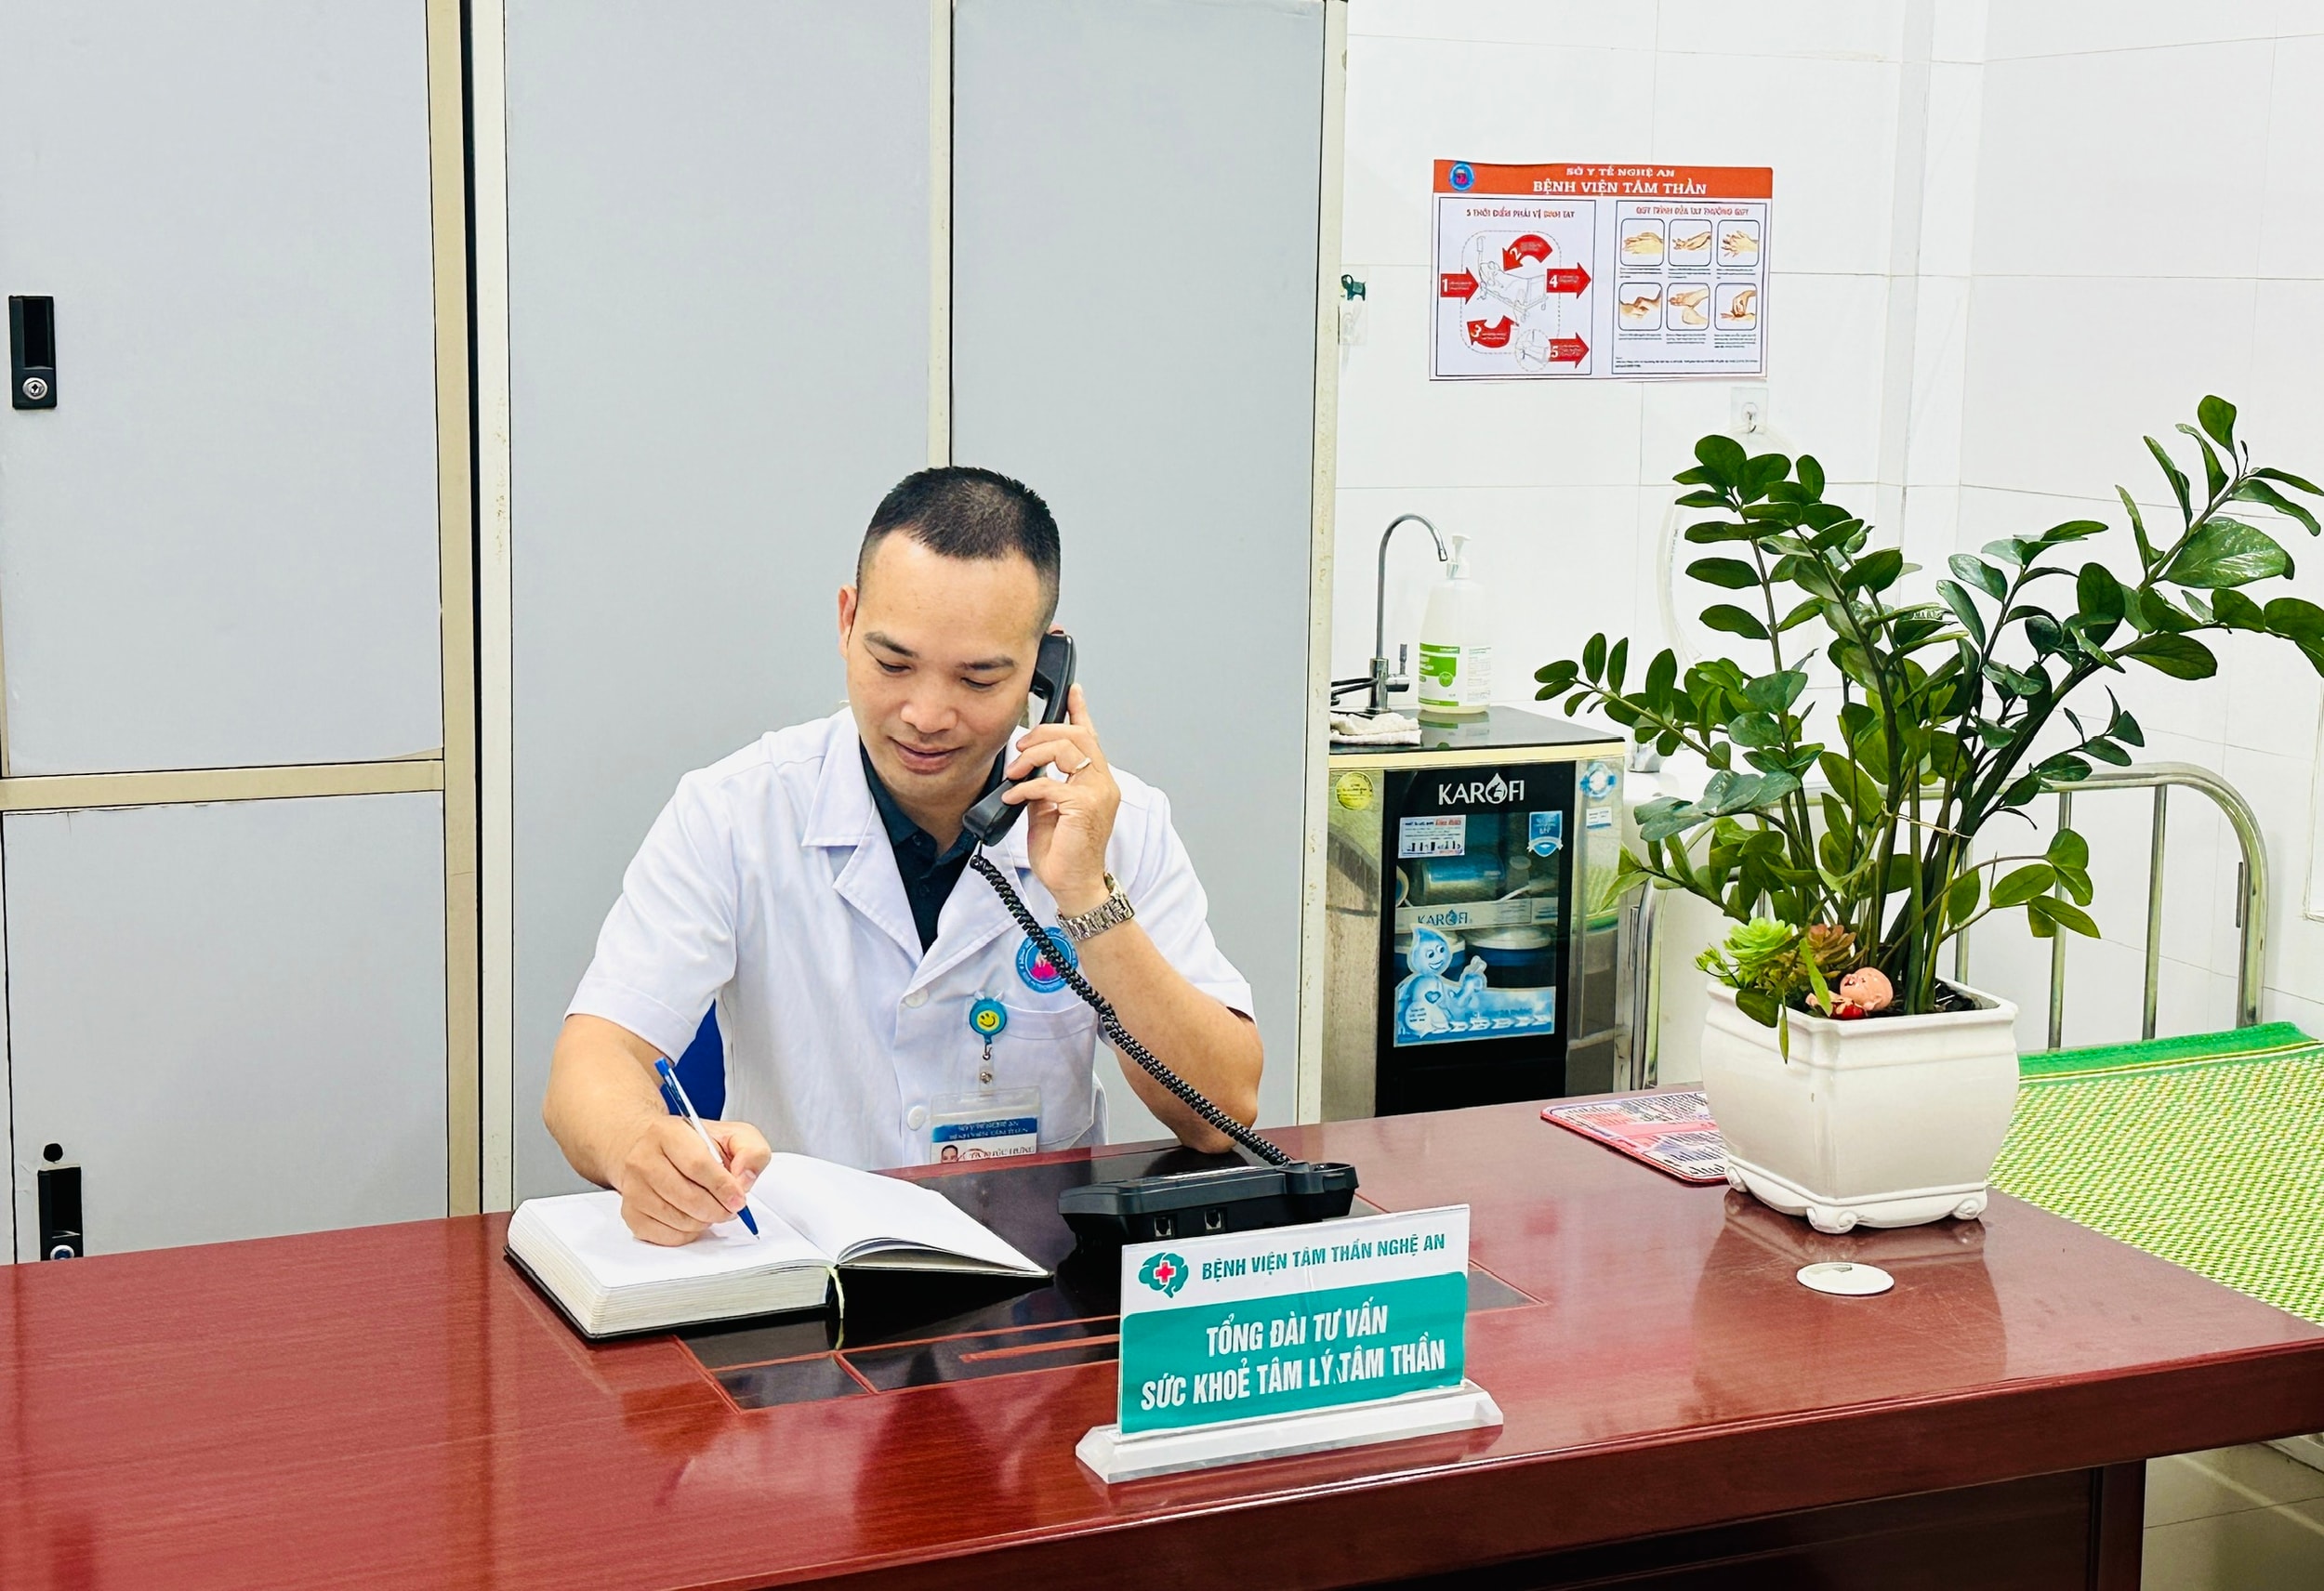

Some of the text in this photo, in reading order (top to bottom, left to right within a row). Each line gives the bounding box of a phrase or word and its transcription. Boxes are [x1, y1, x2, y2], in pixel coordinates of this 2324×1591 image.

[1587, 167, 1596, 176] Y
[1618, 167, 1653, 178] NGHỆ
[1657, 169, 1675, 178] AN
[1533, 178, 1707, 196] BỆNH VIỆN TÂM THẦN
[1510, 247, 1522, 260] 2
[1442, 278, 1448, 293] 1
[1549, 274, 1559, 288] 4
[1471, 324, 1482, 337] 3
[1551, 345, 1559, 358] 5
[1438, 772, 1525, 806] KAROFI
[1202, 1258, 1246, 1282] BỆNH
[1251, 1251, 1287, 1275] VIỆN
[1292, 1246, 1326, 1268] TÂM
[1377, 1234, 1419, 1256] NGHỆ
[1423, 1233, 1446, 1251] AN
[1207, 1296, 1389, 1358] TỔNG ĐÀI TƯ VẤN
[1141, 1373, 1187, 1411] SỨC
[1193, 1358, 1250, 1404] KHOẺ
[1257, 1356, 1302, 1395] TÂM
[1339, 1345, 1385, 1384] TÂM
[1391, 1331, 1446, 1375] THẦN
